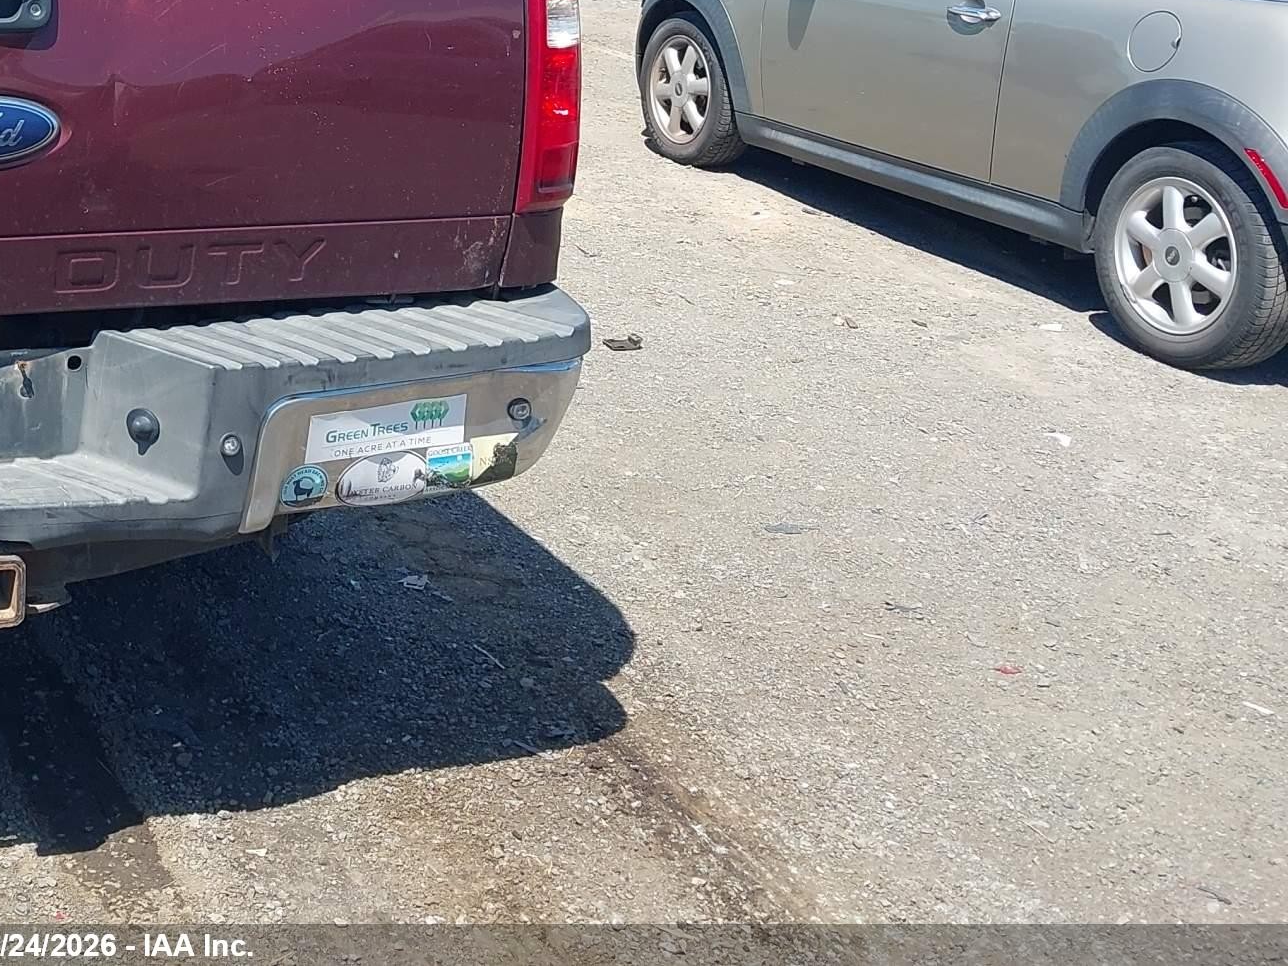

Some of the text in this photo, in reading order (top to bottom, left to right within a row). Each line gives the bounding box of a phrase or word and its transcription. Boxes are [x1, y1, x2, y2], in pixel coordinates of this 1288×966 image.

[54, 239, 328, 294] DUTY
[334, 436, 432, 458] ONE ACRE AT A TIME
